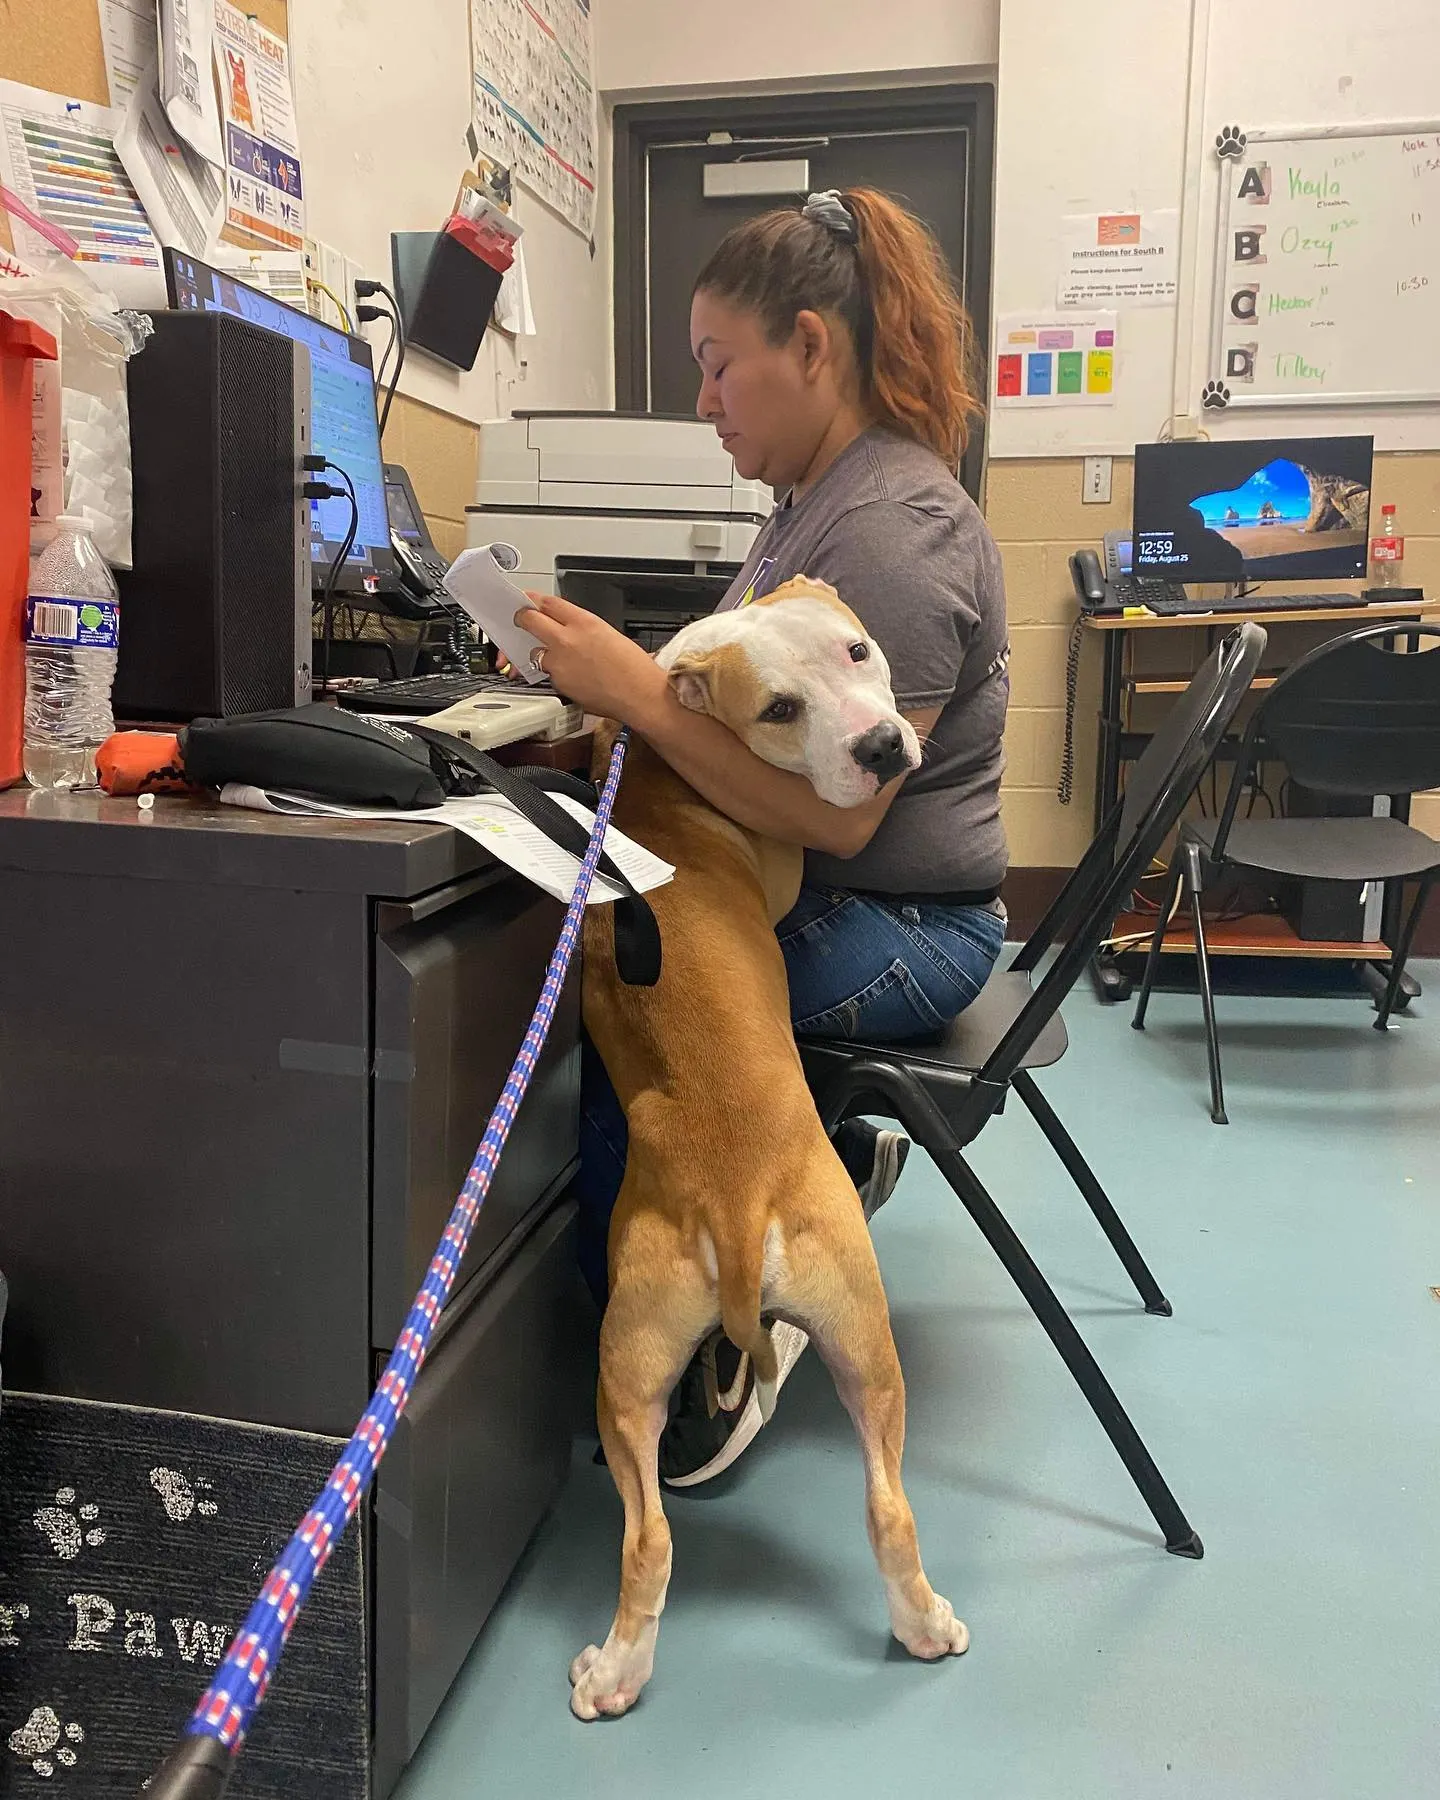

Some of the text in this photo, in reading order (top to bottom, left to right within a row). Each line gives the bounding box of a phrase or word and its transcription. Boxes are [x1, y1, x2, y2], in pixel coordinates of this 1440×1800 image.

[258, 33, 285, 64] HEAT
[1238, 168, 1265, 198] A
[1072, 249, 1118, 258] Instructions
[1120, 248, 1131, 257] for
[1133, 247, 1157, 256] South
[1235, 231, 1260, 261] B
[1231, 290, 1256, 319] C
[1227, 349, 1253, 376] D
[1138, 553, 1189, 563] Friday, August 25
[1139, 540, 1173, 555] 12:59
